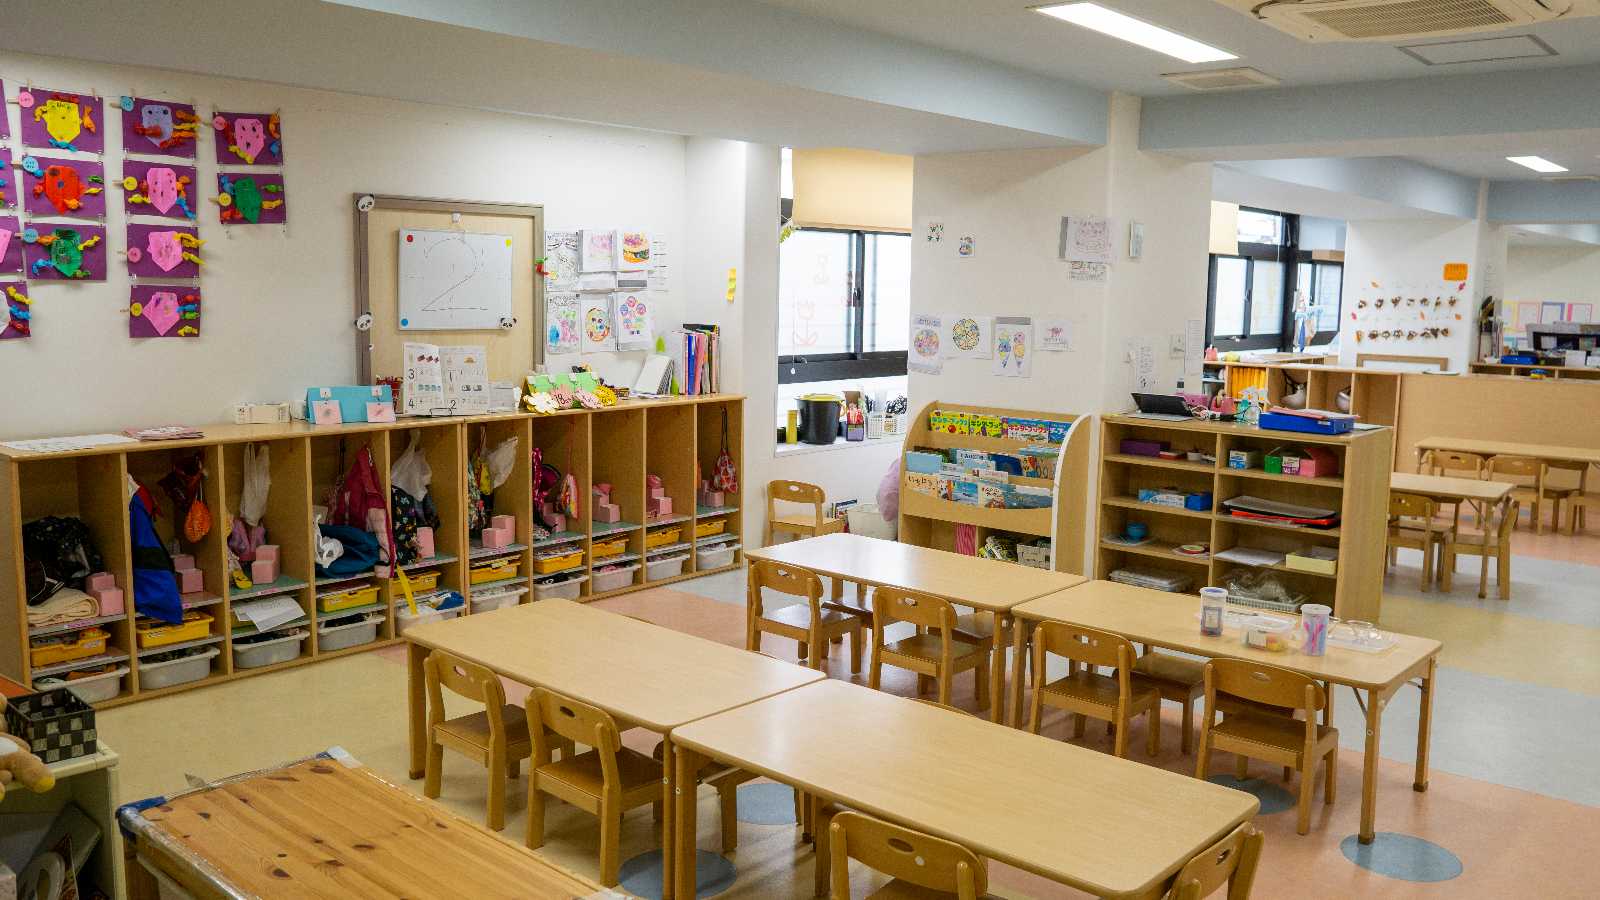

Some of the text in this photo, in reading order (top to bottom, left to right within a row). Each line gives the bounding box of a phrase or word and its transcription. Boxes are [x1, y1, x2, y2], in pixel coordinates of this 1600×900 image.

[408, 369, 415, 380] 3
[408, 399, 415, 409] 4
[450, 400, 457, 410] 2
